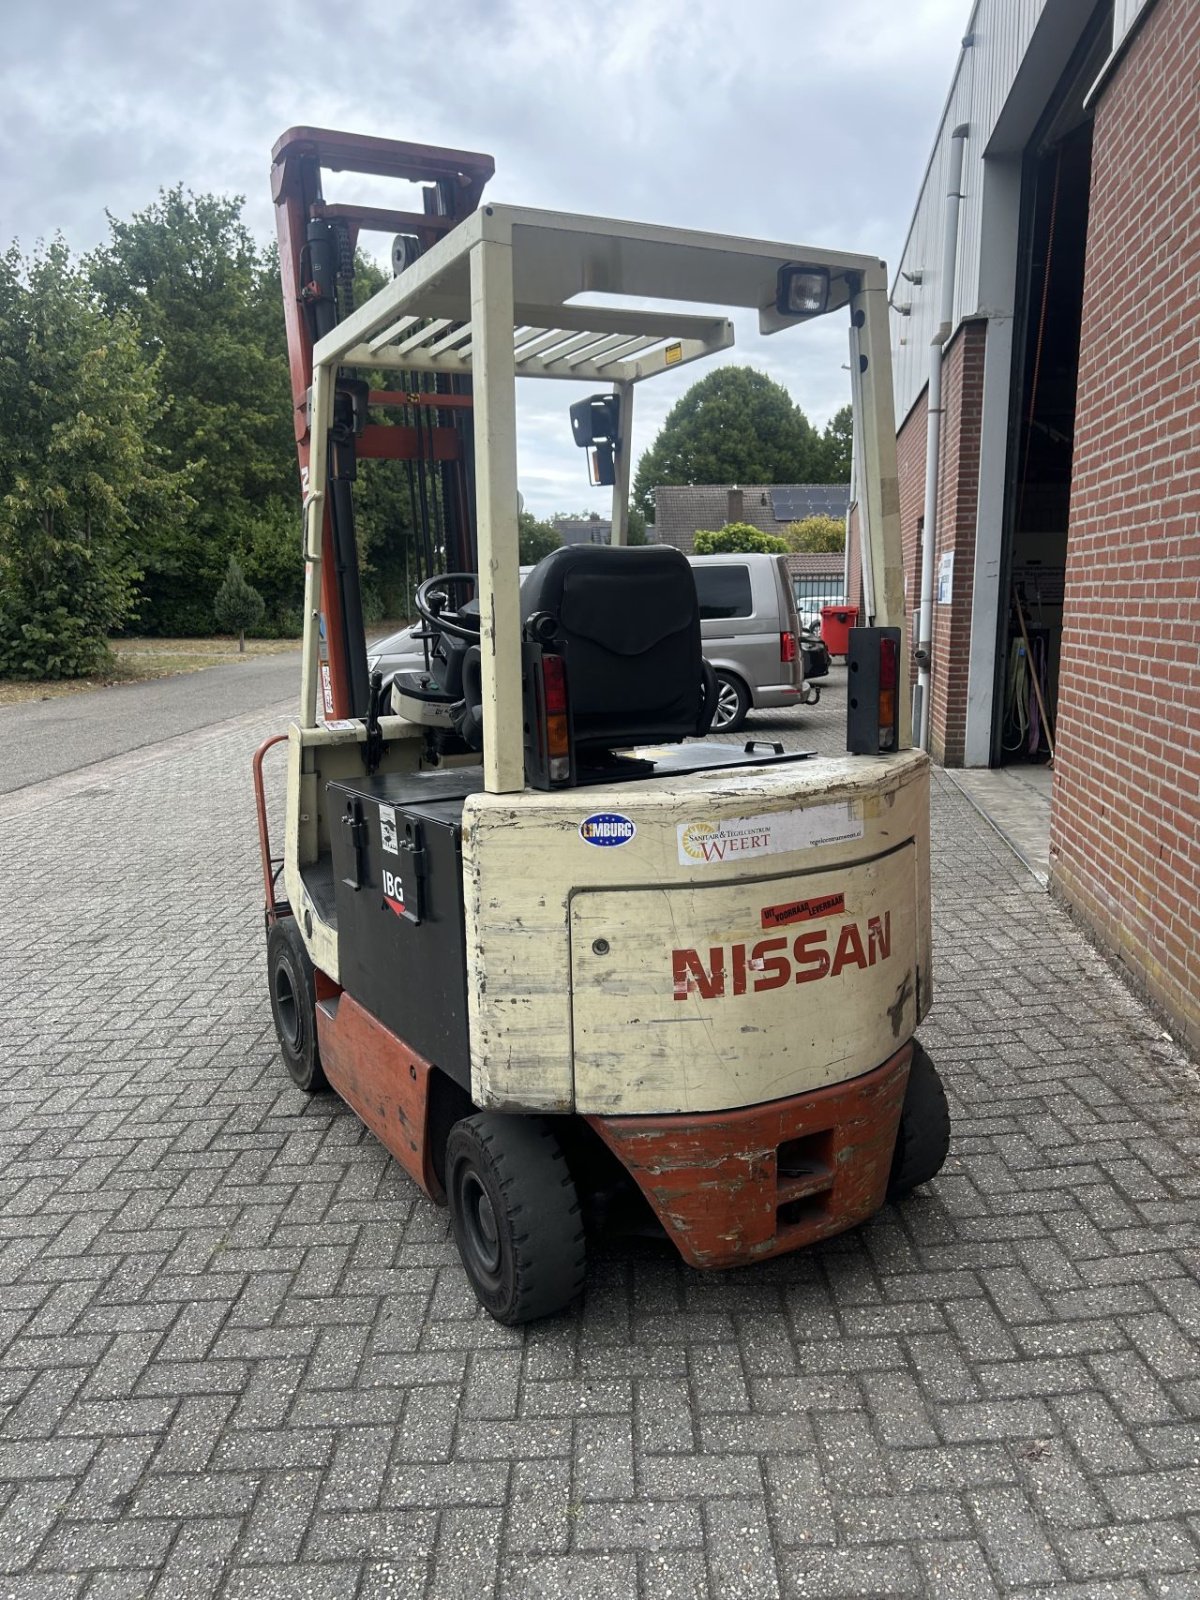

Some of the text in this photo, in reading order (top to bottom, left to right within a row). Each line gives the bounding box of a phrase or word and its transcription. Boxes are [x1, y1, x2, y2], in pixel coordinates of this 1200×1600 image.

[583, 822, 632, 837] LIMBURG
[700, 833, 771, 861] WEERT
[382, 869, 404, 902] IBG
[763, 895, 844, 922] UIT VOORRAAD LEVERBAAR
[671, 910, 891, 1001] NISSAN
